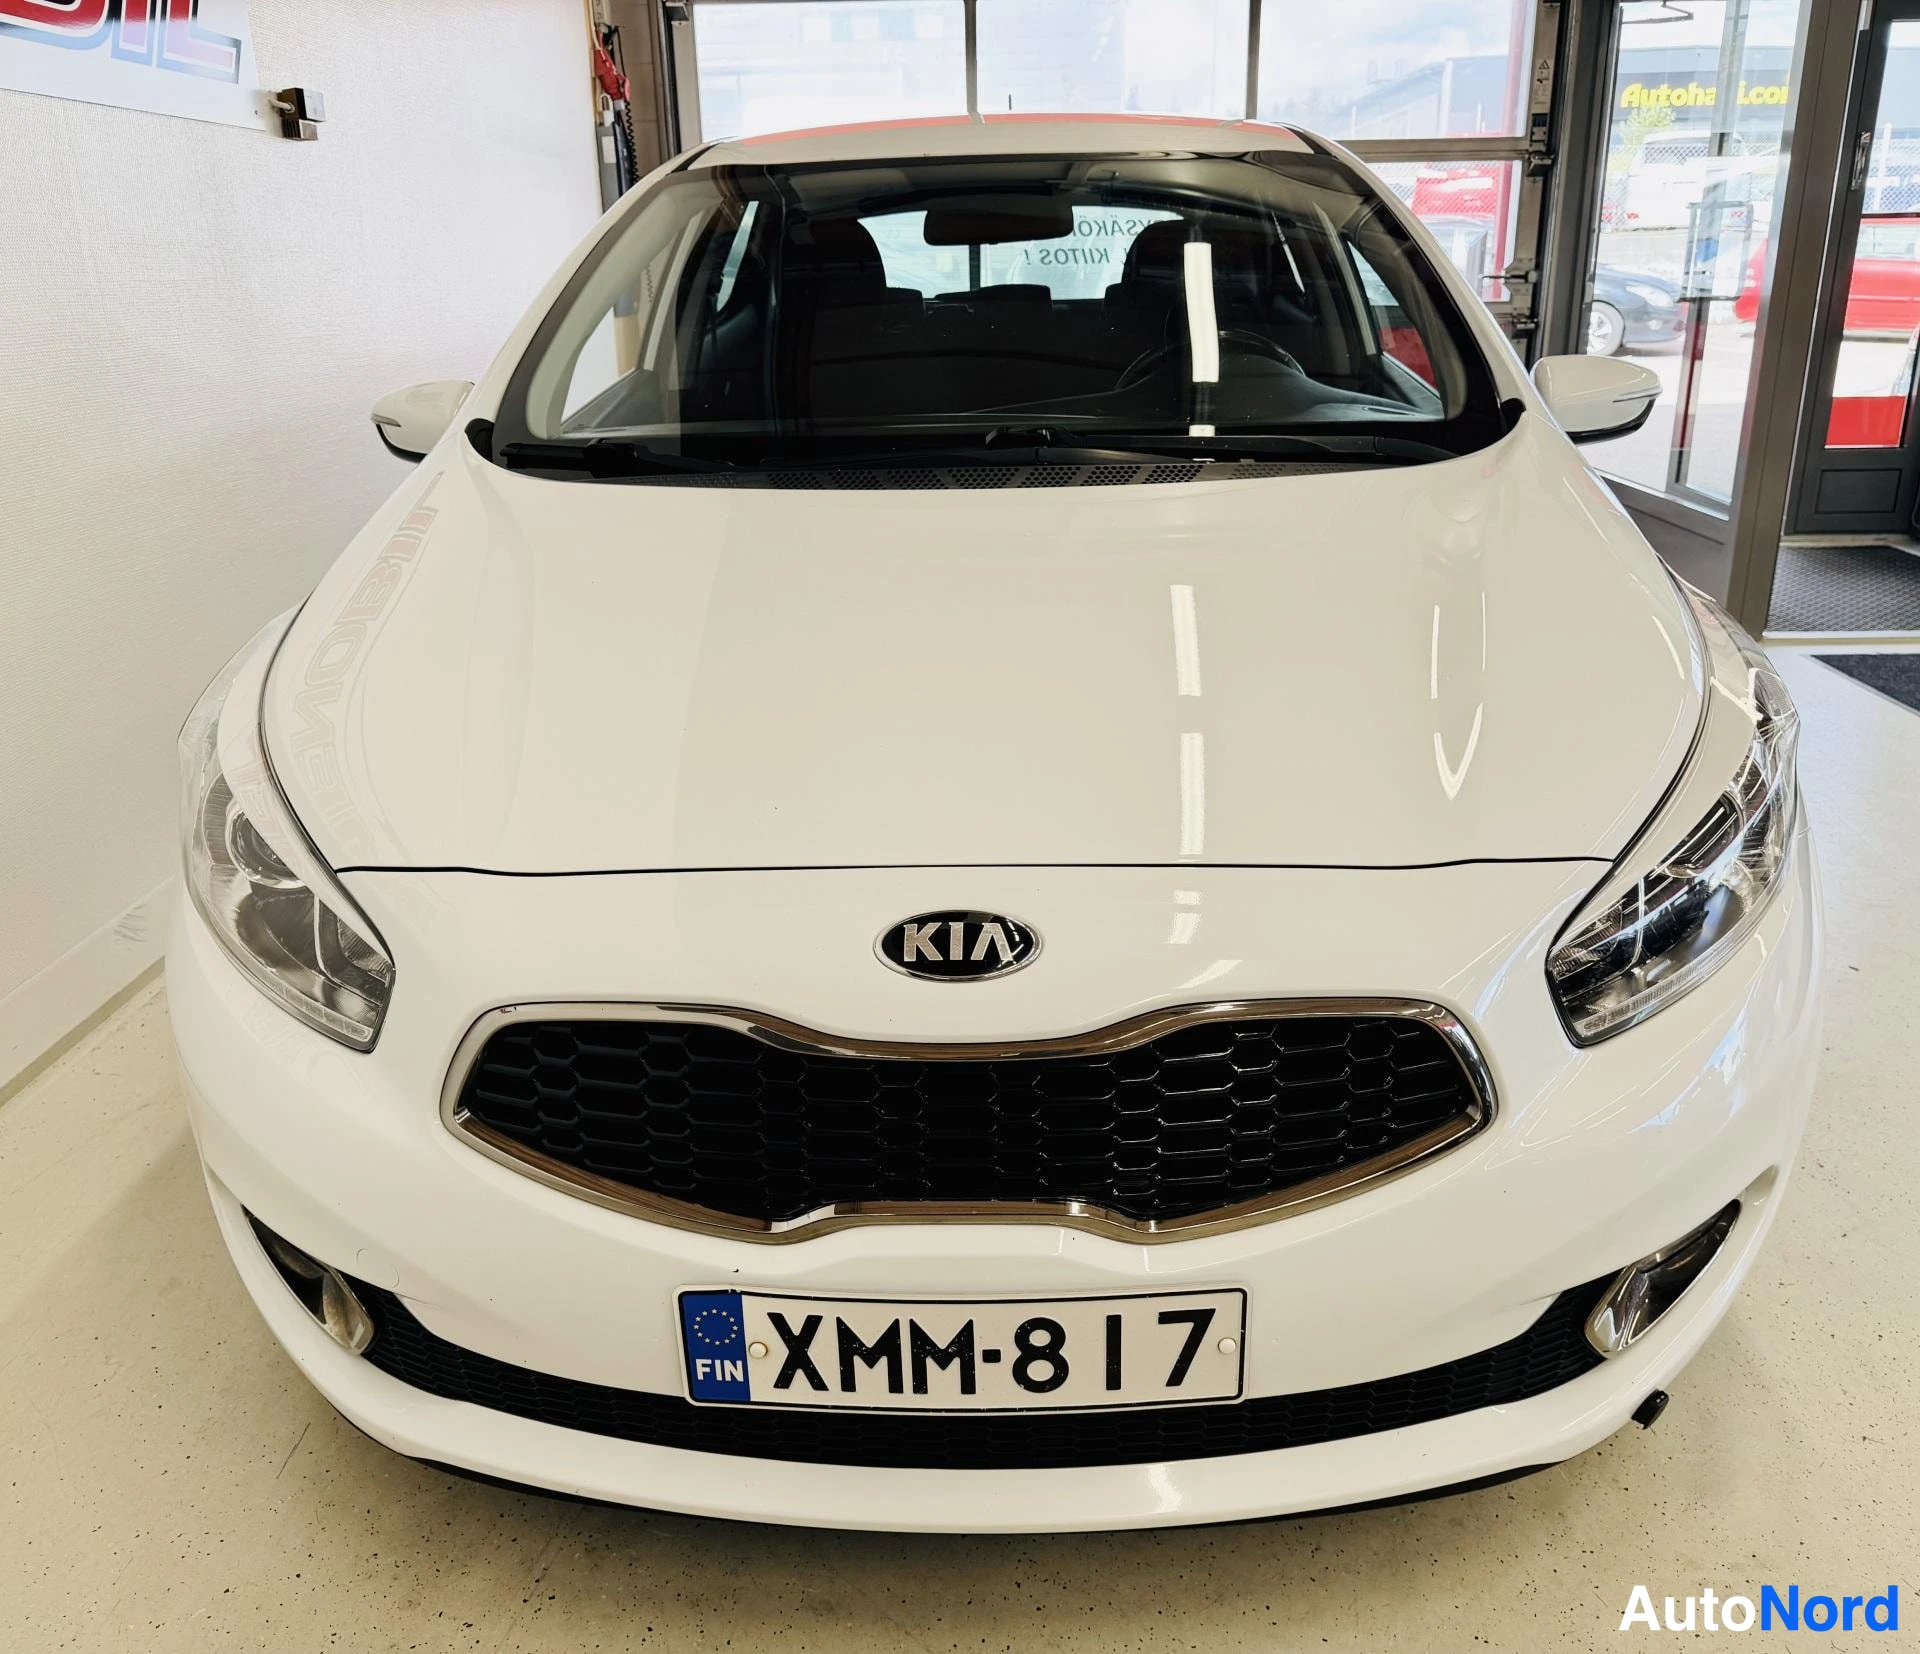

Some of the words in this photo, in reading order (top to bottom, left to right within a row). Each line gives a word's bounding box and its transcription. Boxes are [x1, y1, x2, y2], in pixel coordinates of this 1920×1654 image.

[903, 921, 1014, 962] KIA
[695, 1357, 744, 1383] FIN
[766, 1307, 1217, 1396] XMM-817
